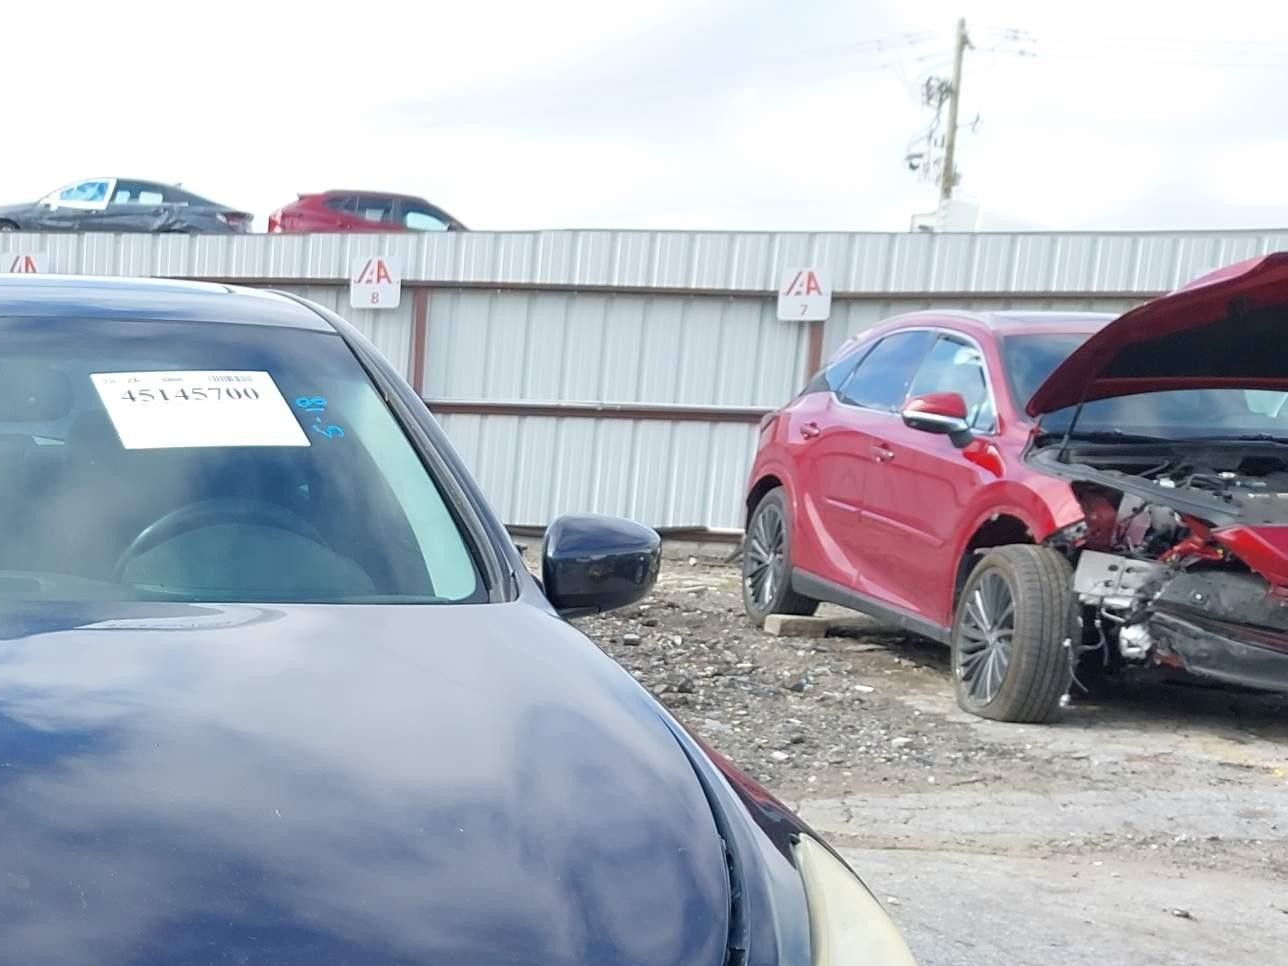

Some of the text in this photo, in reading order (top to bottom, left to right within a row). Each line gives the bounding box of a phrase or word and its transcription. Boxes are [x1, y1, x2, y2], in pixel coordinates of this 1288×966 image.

[370, 292, 380, 304] 8
[799, 303, 809, 316] 7
[121, 387, 260, 402] 45145700
